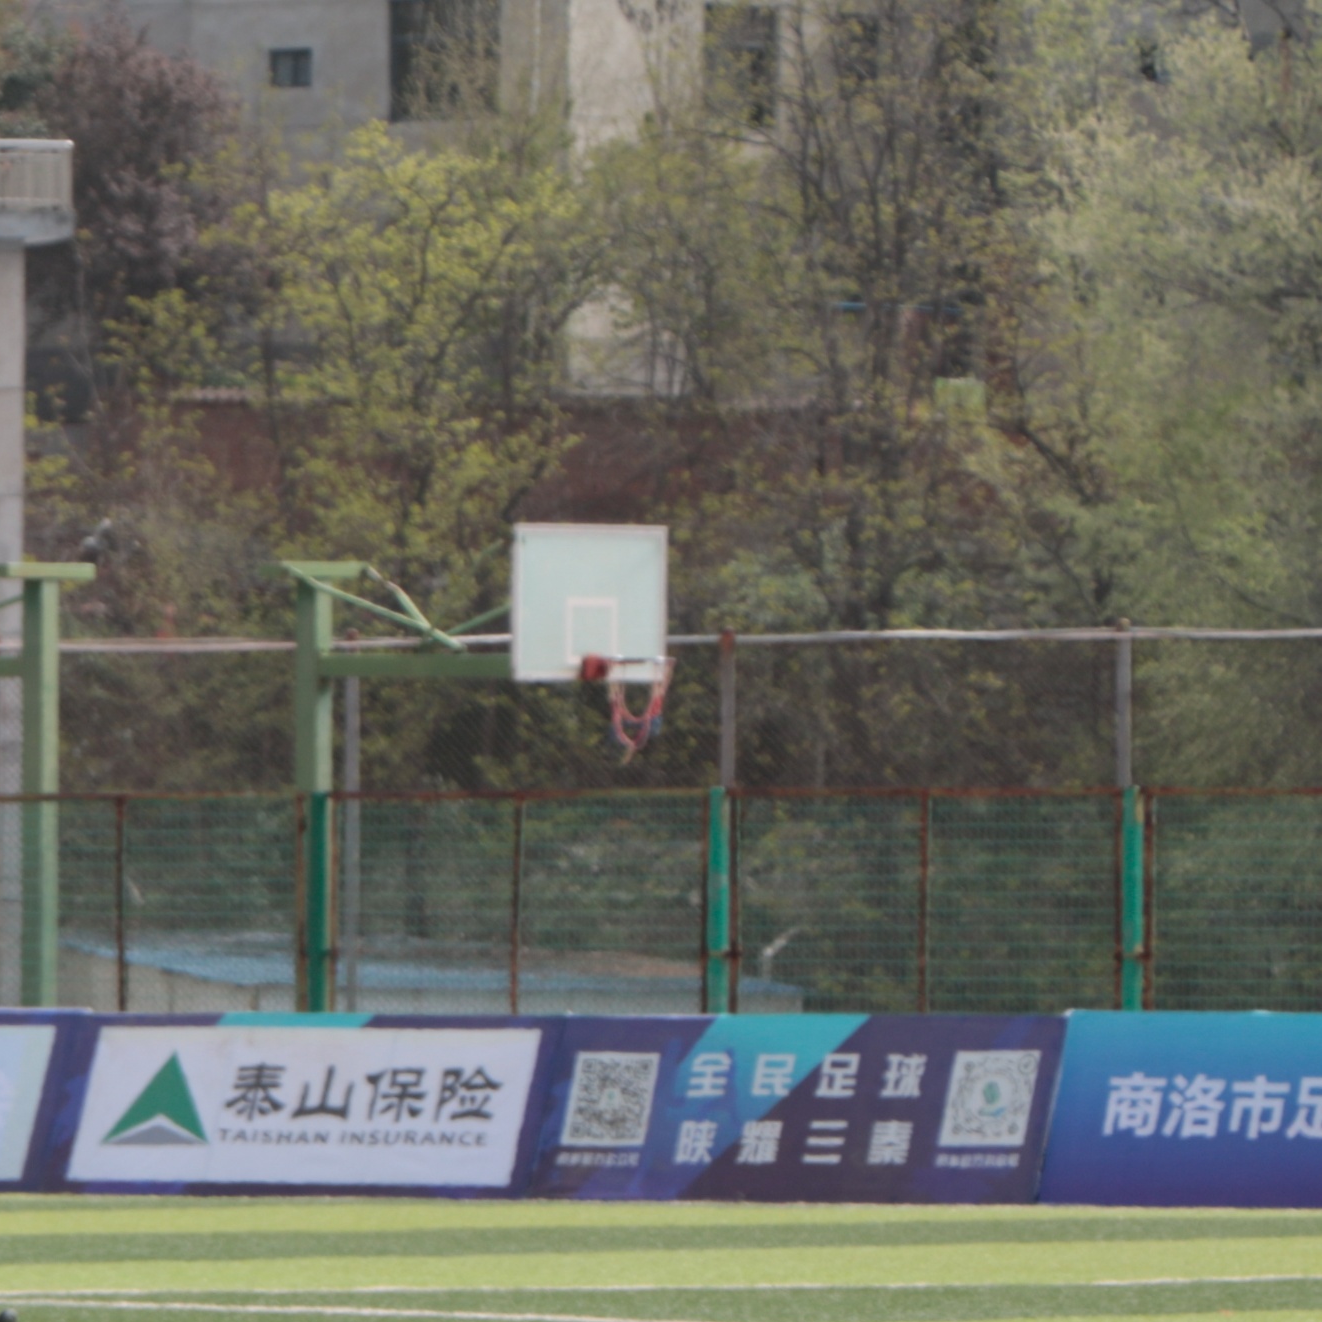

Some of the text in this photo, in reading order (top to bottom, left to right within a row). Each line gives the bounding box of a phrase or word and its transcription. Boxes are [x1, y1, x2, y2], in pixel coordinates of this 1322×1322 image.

[225, 1062, 504, 1122] 泰山保险
[687, 1052, 928, 1097] 全民足球
[218, 1127, 489, 1147] TAISHAN INSURANCE
